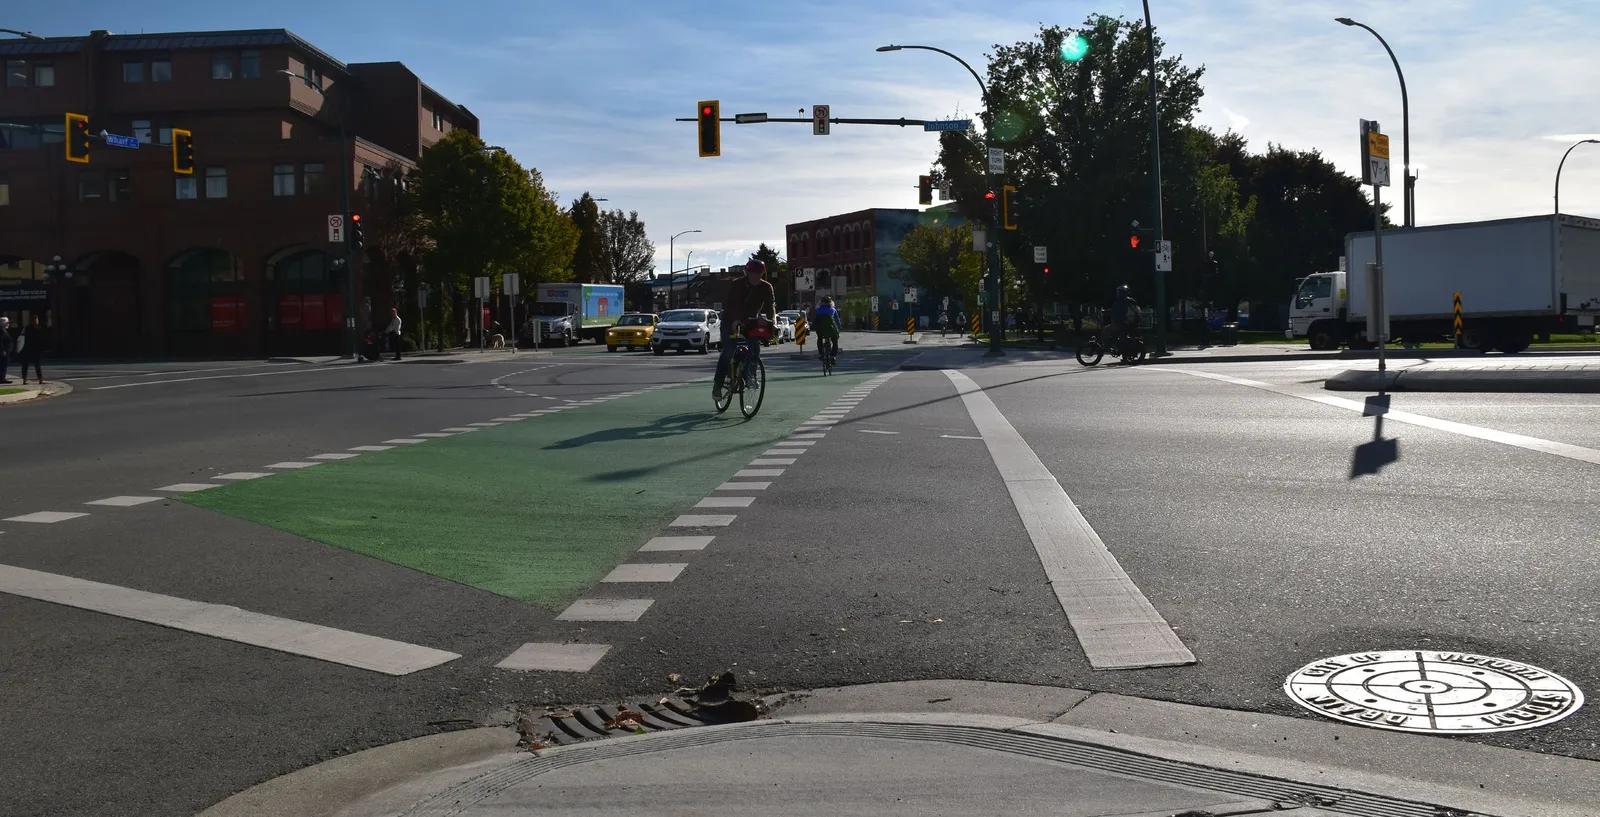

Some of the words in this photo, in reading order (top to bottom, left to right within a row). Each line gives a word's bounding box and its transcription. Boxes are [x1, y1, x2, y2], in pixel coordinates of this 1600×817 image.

[107, 135, 128, 145] Wharf
[926, 122, 959, 131] Johnson
[1302, 658, 1348, 677] CITY
[1350, 653, 1382, 664] OF
[1438, 652, 1549, 681] VICTORIA
[1305, 695, 1409, 725] DRAIN
[1480, 693, 1569, 726] STORM
